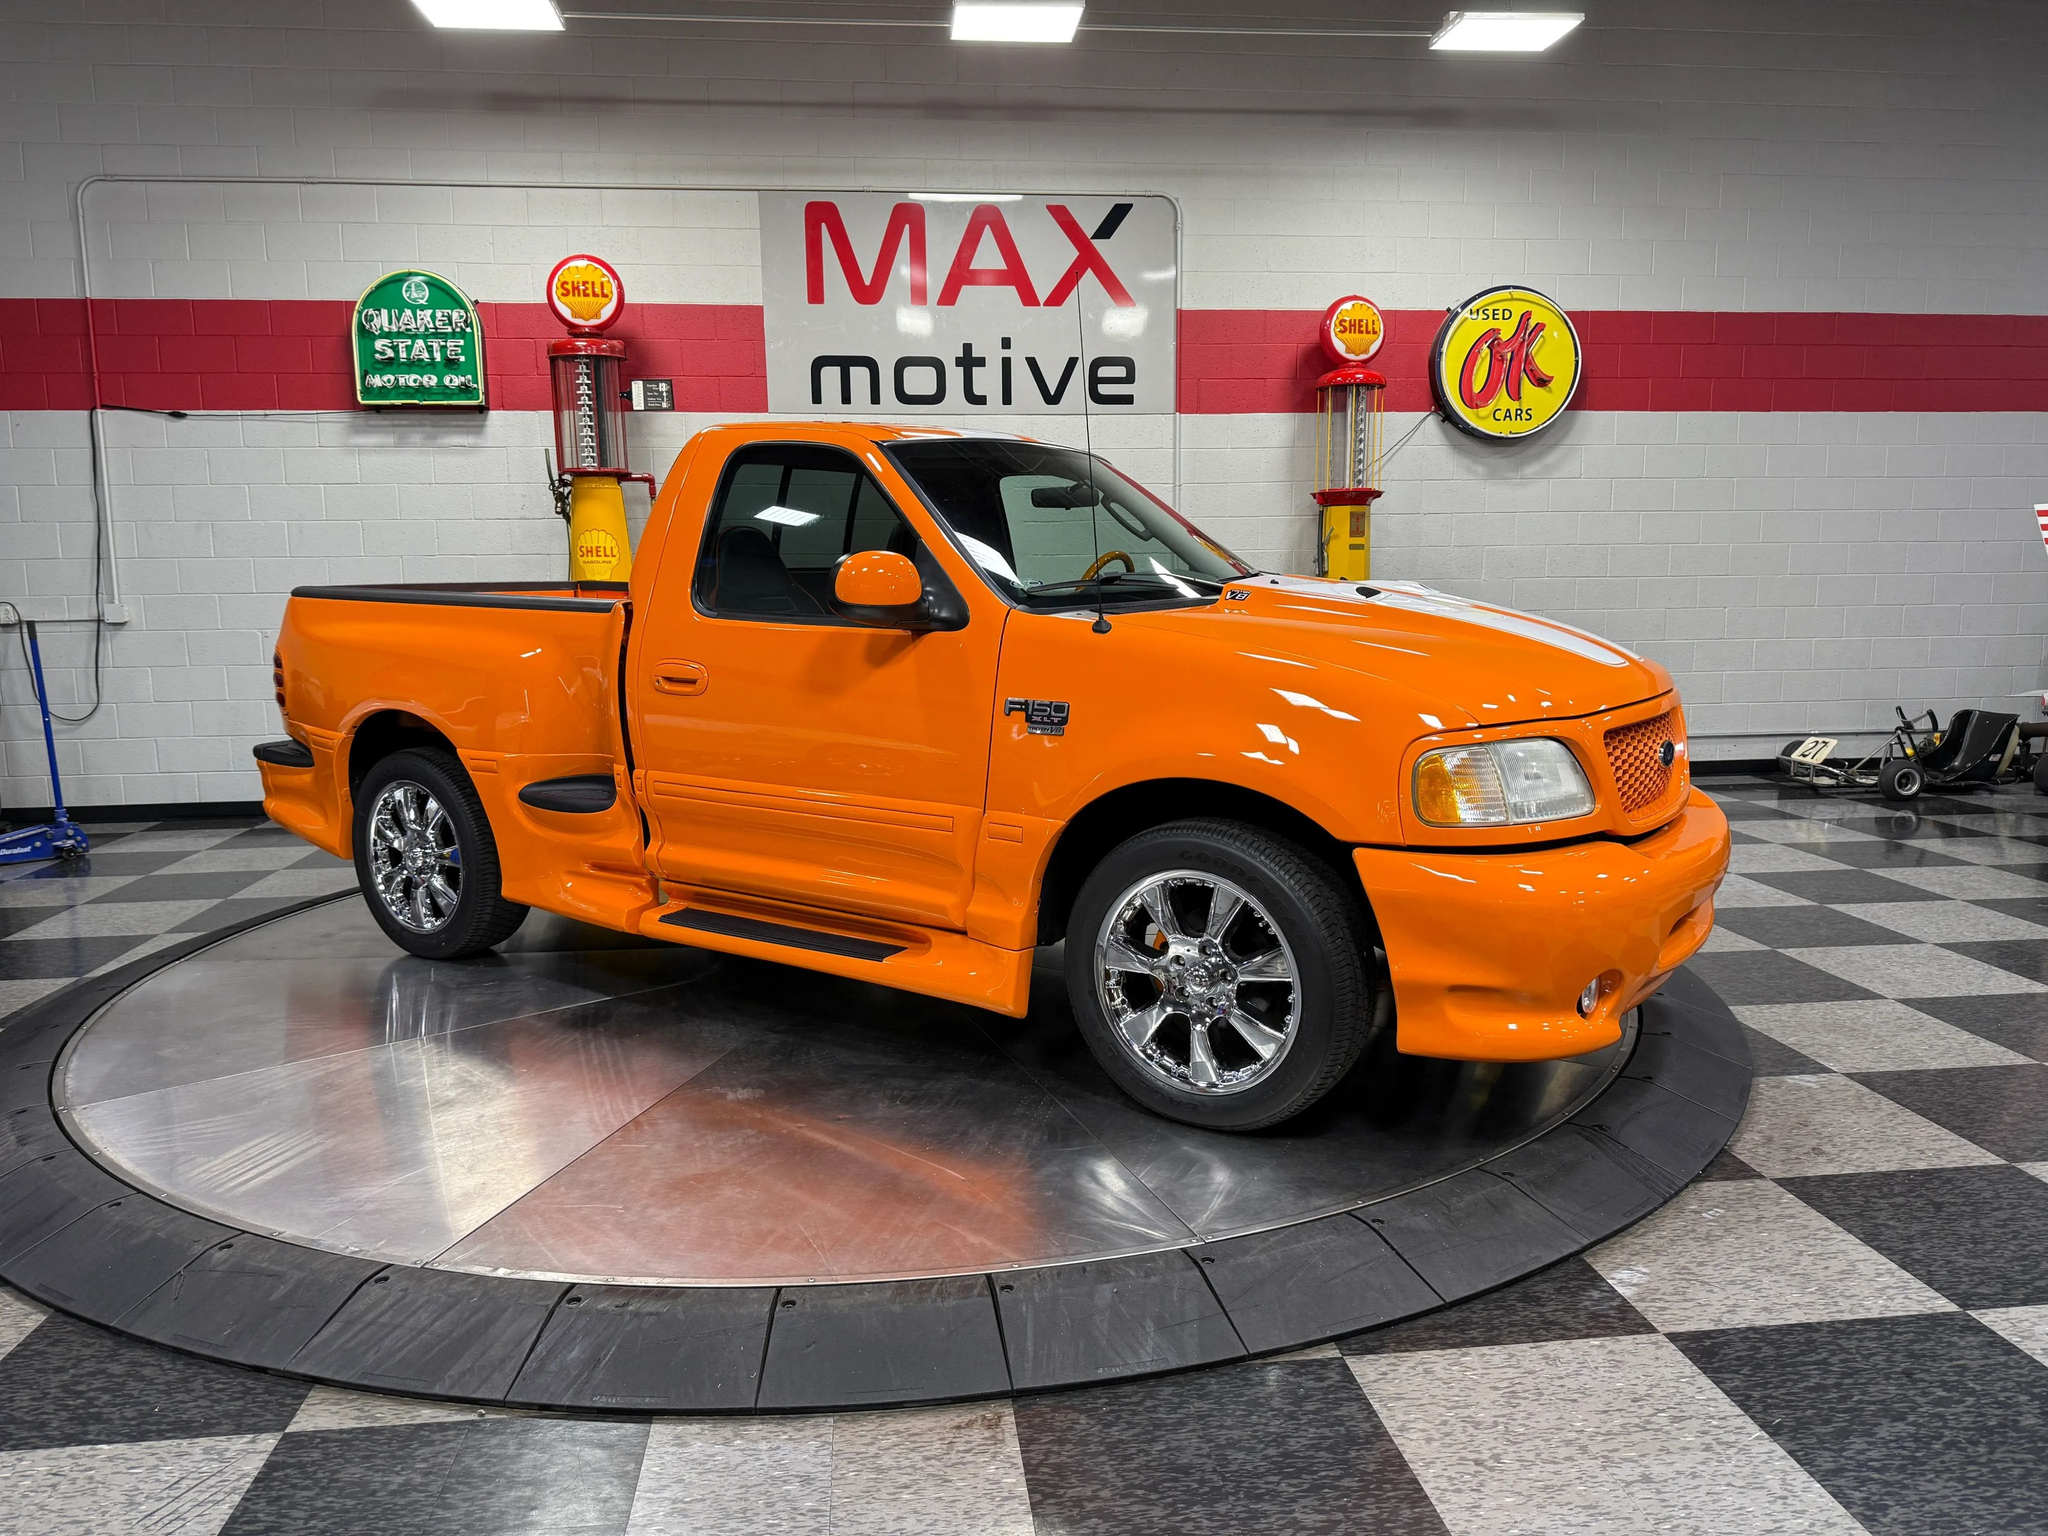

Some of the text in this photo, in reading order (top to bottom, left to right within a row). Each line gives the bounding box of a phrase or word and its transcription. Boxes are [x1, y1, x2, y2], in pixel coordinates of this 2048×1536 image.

[804, 200, 1136, 307] MAX
[560, 280, 609, 298] SHELL
[362, 308, 472, 335] QUAKER
[1470, 308, 1512, 321] USED
[1338, 318, 1378, 335] SHELL
[374, 339, 465, 362] STATE
[1459, 310, 1554, 409] OK
[811, 336, 1136, 405] motive
[365, 374, 478, 389] MOTOR OIL
[1492, 408, 1533, 422] CARS
[579, 545, 616, 557] SHELL
[1050, 726, 1062, 734] V8
[1797, 740, 1830, 760] 27
[0, 846, 32, 855] Duralast
[1178, 849, 1310, 950] GOODYEAR
